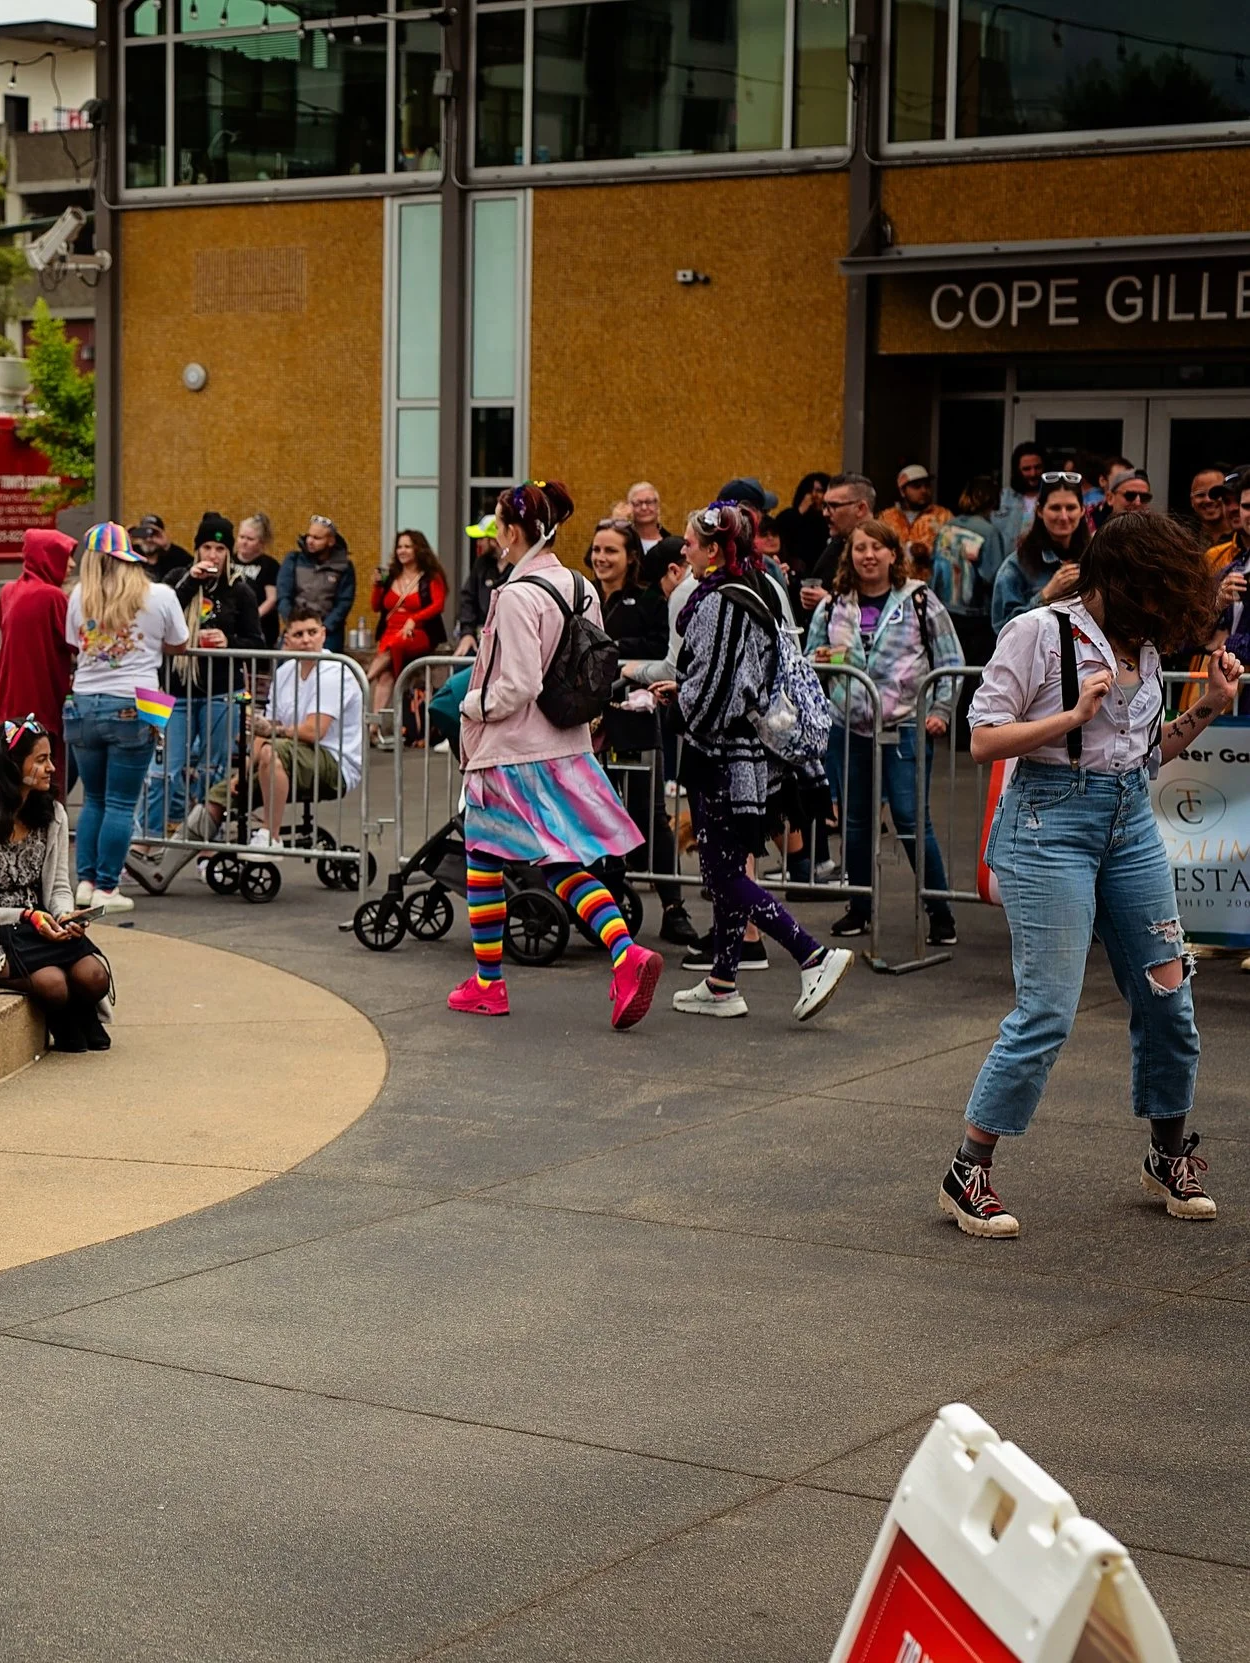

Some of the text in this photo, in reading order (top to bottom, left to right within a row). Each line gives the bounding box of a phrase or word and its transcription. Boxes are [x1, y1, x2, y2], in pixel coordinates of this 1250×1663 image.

[930, 277, 1080, 330] COPE
[1178, 750, 1213, 762] eer
[1174, 868, 1250, 892] ESTA
